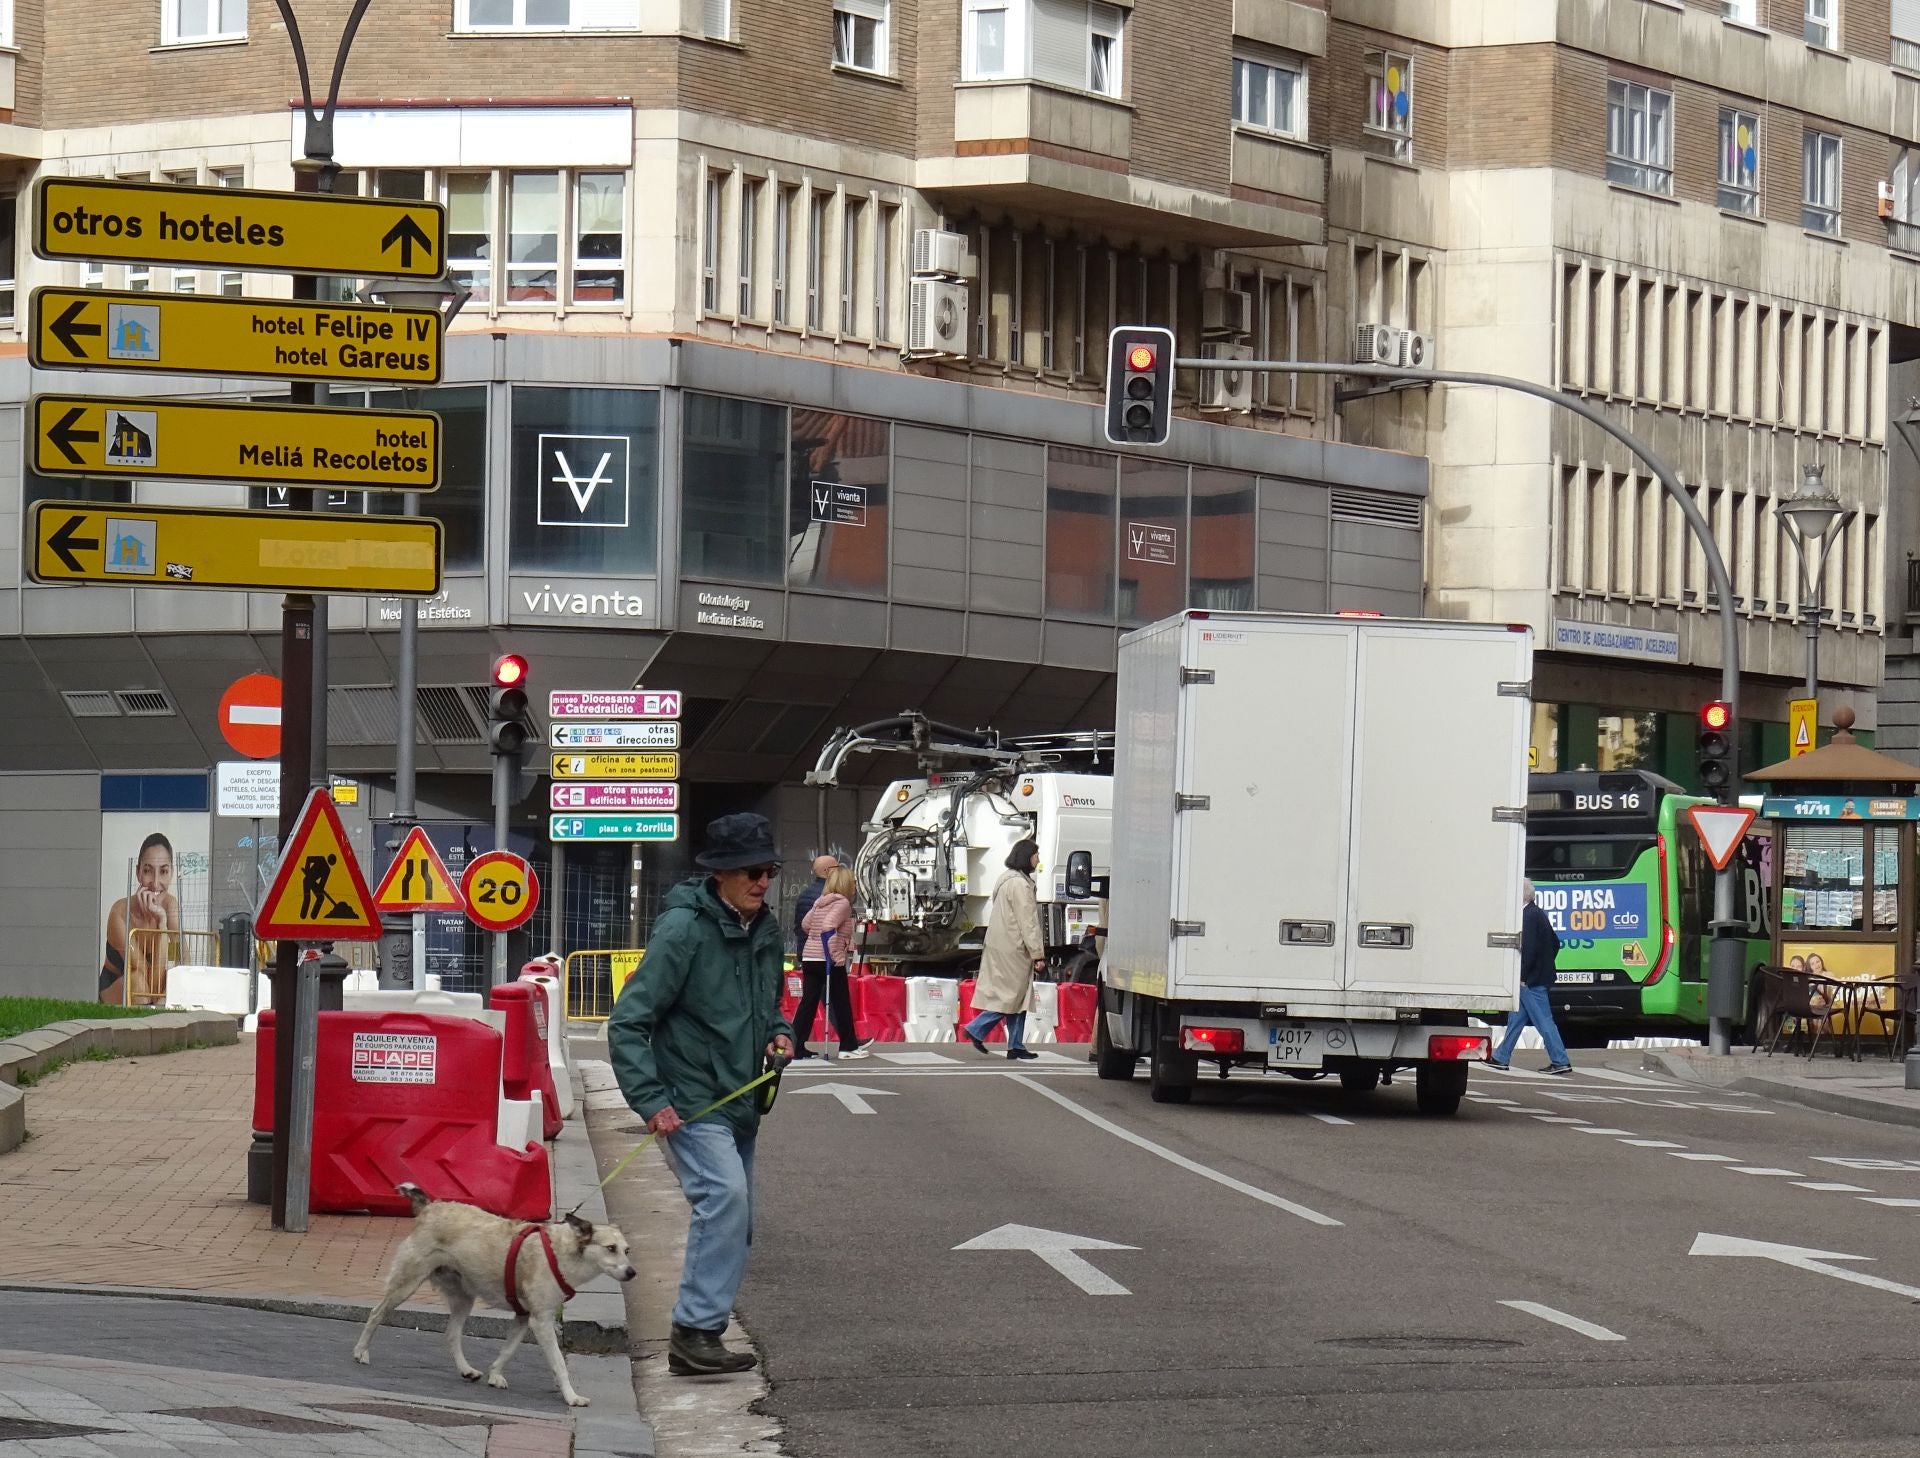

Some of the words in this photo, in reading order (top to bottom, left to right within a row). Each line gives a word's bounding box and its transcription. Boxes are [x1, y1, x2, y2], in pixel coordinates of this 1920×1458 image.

[53, 206, 142, 238] otros
[159, 211, 284, 247] hoteles
[252, 315, 304, 335] hotel
[315, 314, 393, 344] Felipe
[406, 318, 430, 341] IV
[275, 346, 328, 366] hotel
[339, 344, 430, 371] Gareus
[376, 429, 427, 448] hotel
[240, 444, 303, 467] Meliá
[313, 447, 427, 472] Recoletos
[837, 489, 860, 502] vivanta
[523, 584, 643, 616] vivanta
[699, 592, 744, 610] Odontología
[744, 600, 750, 611] y
[429, 606, 471, 618] Estética
[698, 611, 732, 626] Medicina
[733, 614, 764, 629] Estética
[1558, 628, 1580, 644] CENTRO
[1583, 630, 1590, 645] DE
[1593, 632, 1643, 651] ADELGAZAMIENTO
[1645, 638, 1677, 655] ACELERADO
[582, 694, 636, 704] Diocesano
[553, 706, 559, 714] y
[565, 703, 633, 714] Catredralicio
[648, 725, 675, 734] otras
[616, 735, 675, 745] direcciones
[591, 755, 619, 763] oficina
[625, 755, 635, 763] de
[641, 755, 674, 763] turismo
[940, 775, 969, 785] moro
[603, 786, 626, 795] otros
[630, 786, 663, 795] museos
[668, 787, 674, 796] y
[590, 796, 627, 805] edificios
[631, 795, 674, 805] históricos
[1072, 796, 1096, 806] moro
[1575, 794, 1613, 810] BUS
[1620, 793, 1640, 809] 16
[1794, 804, 1831, 815] 11/11
[599, 825, 619, 834] plaza
[623, 825, 632, 833] de
[636, 822, 674, 833] Zorrilla
[1555, 873, 1584, 881] IVECO
[479, 878, 521, 905] 20
[1571, 889, 1616, 910] PASA
[1548, 911, 1567, 931] EL
[1570, 910, 1606, 931] CDO
[1613, 911, 1639, 925] cdo
[1575, 973, 1592, 981] KFK
[355, 1034, 398, 1043] ALQUILER
[1277, 1030, 1312, 1044] 4017
[355, 1052, 432, 1065] BLAPE
[1276, 1046, 1302, 1060] LPY
